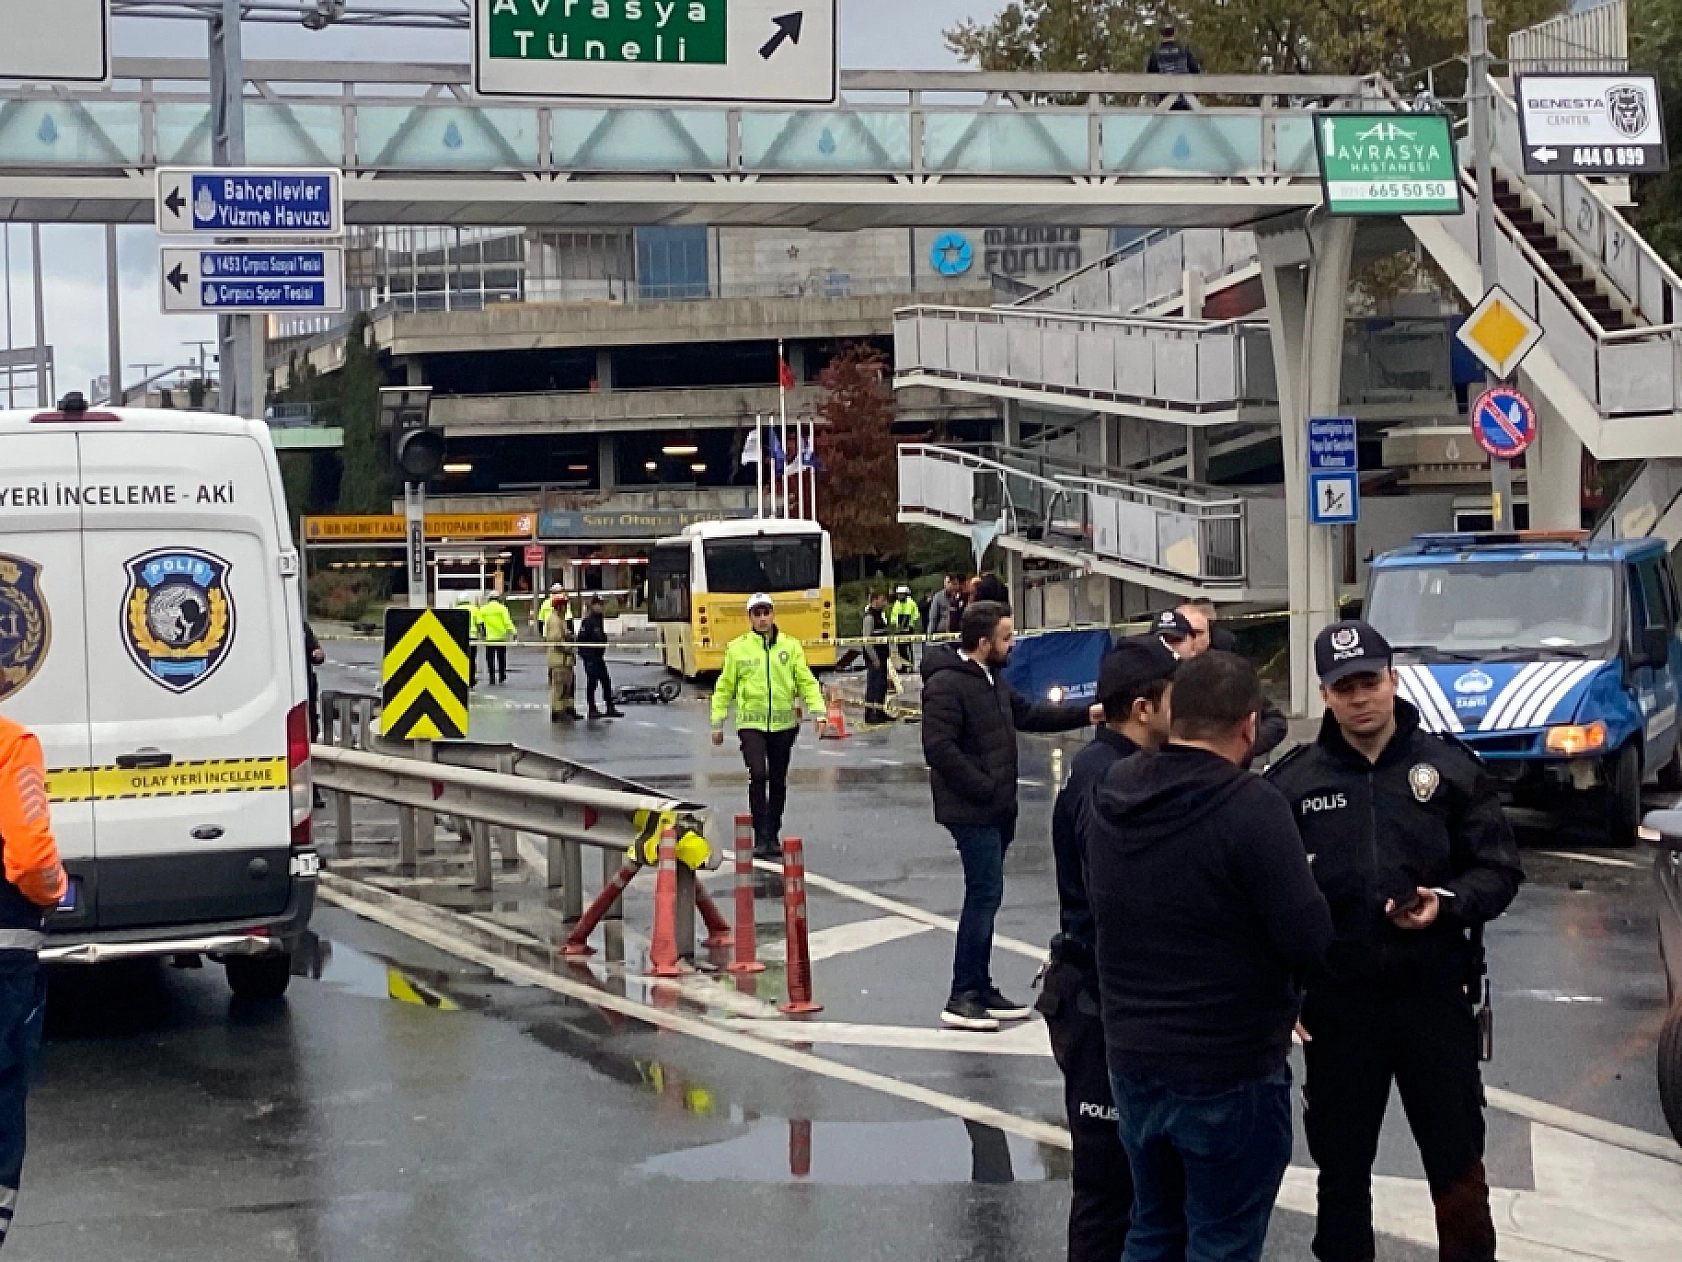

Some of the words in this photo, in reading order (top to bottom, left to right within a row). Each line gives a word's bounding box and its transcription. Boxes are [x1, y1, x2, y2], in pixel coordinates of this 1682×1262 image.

[492, 0, 706, 27] Avrasya
[513, 30, 686, 61] Tüneli
[1528, 98, 1604, 110] BENESTA
[1338, 144, 1441, 161] AVRASYA
[1572, 147, 1602, 166] 444
[224, 179, 323, 203] Bahçelievler
[1368, 183, 1399, 198] 665
[1402, 183, 1422, 197] 50
[1425, 183, 1446, 197] 50
[218, 204, 271, 226] Yüzme
[275, 205, 331, 226] Havuzu
[216, 255, 241, 272] 1453
[255, 284, 282, 304] Spor
[0, 481, 49, 507] YERİ
[56, 480, 177, 506] İNCELEME
[196, 479, 235, 505] AKİ
[434, 519, 480, 535] OTOPARK
[131, 775, 167, 788] OLAY
[171, 771, 202, 786] YERİ
[205, 768, 272, 785] İNCELEME
